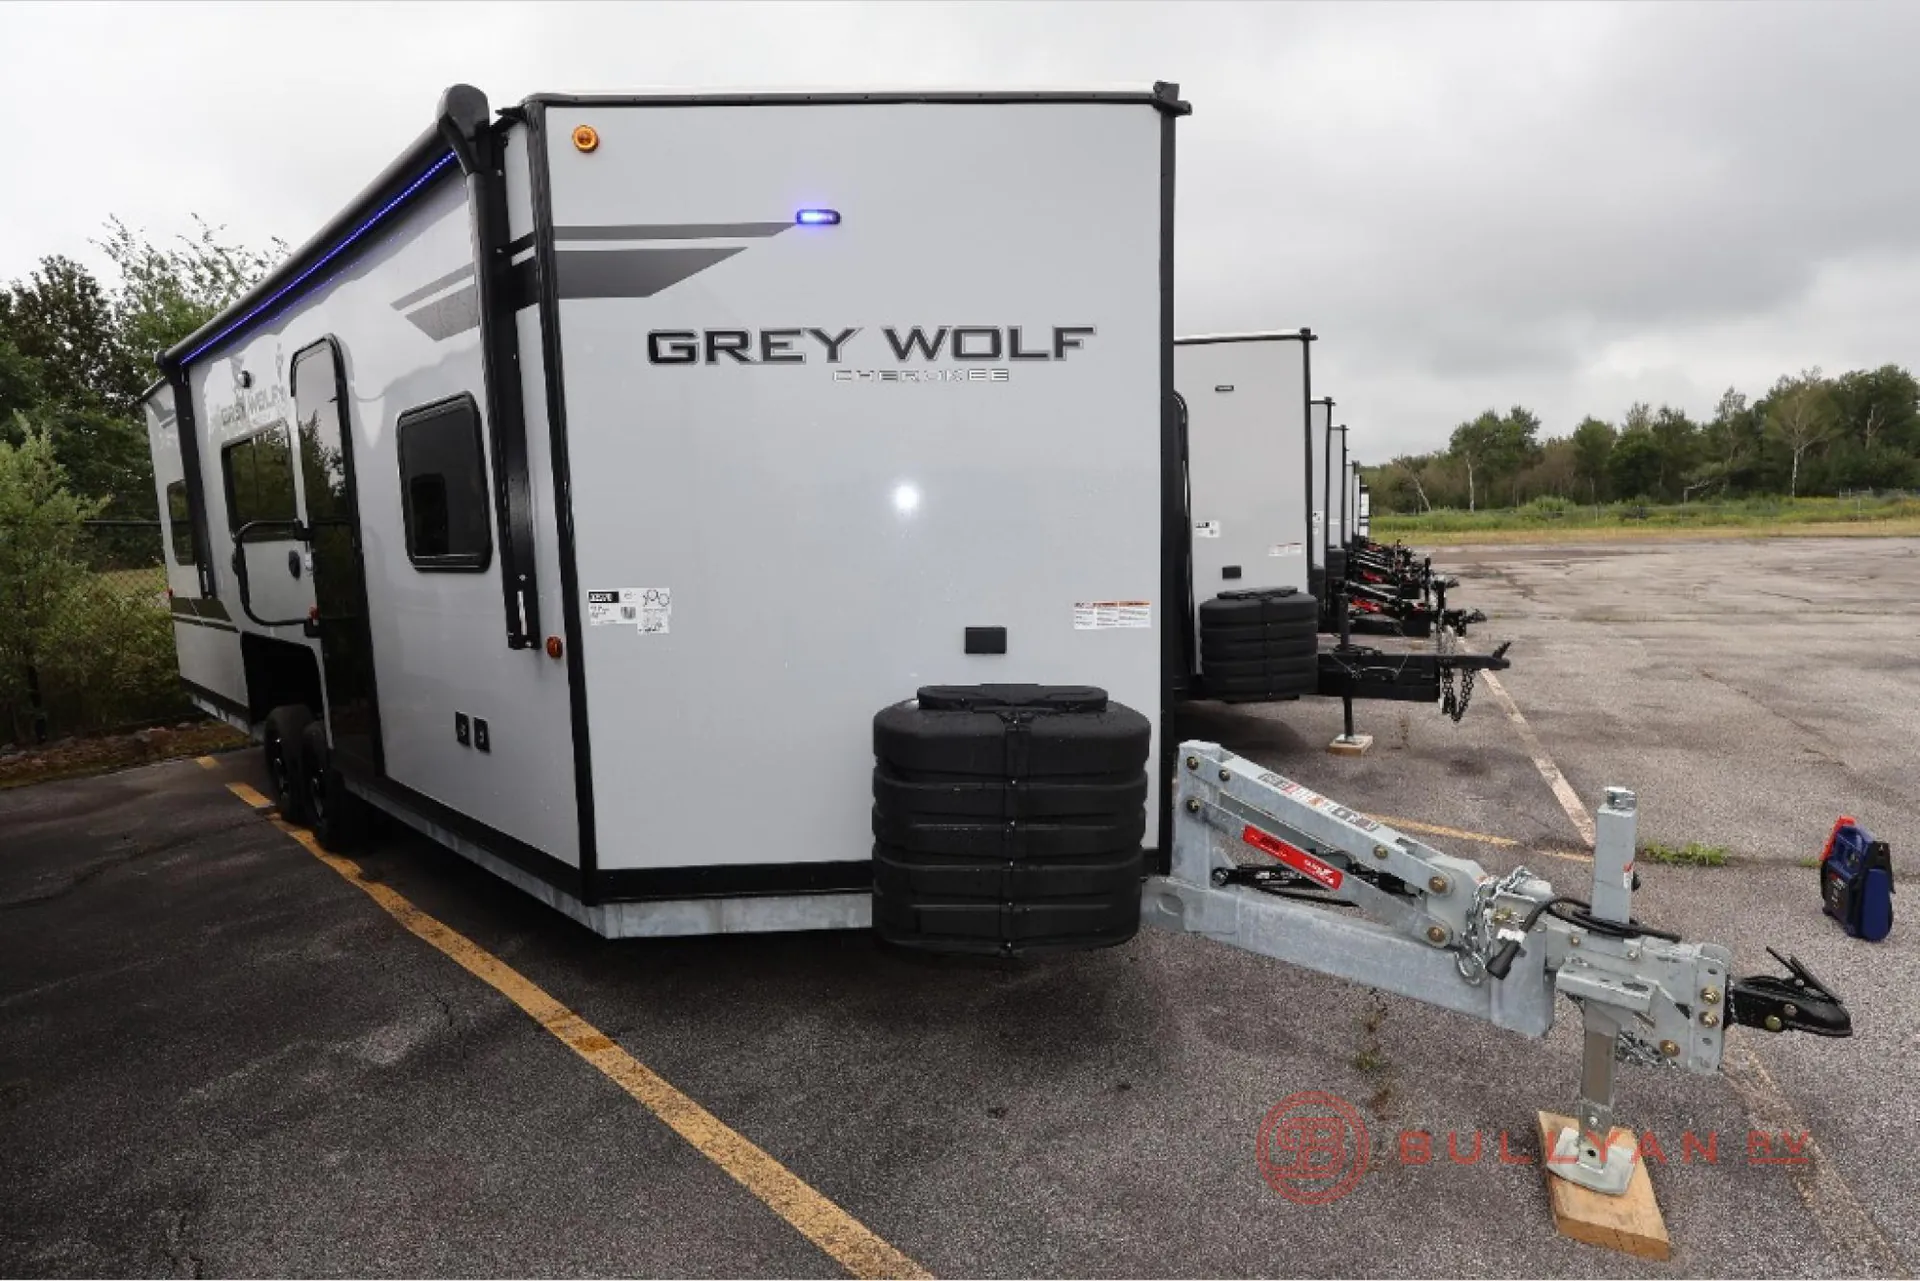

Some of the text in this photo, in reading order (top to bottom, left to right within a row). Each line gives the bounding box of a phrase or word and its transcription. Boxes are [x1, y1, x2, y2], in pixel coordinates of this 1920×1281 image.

[647, 324, 1097, 365] GREY WOLF
[832, 368, 1010, 383] CHEROKEE
